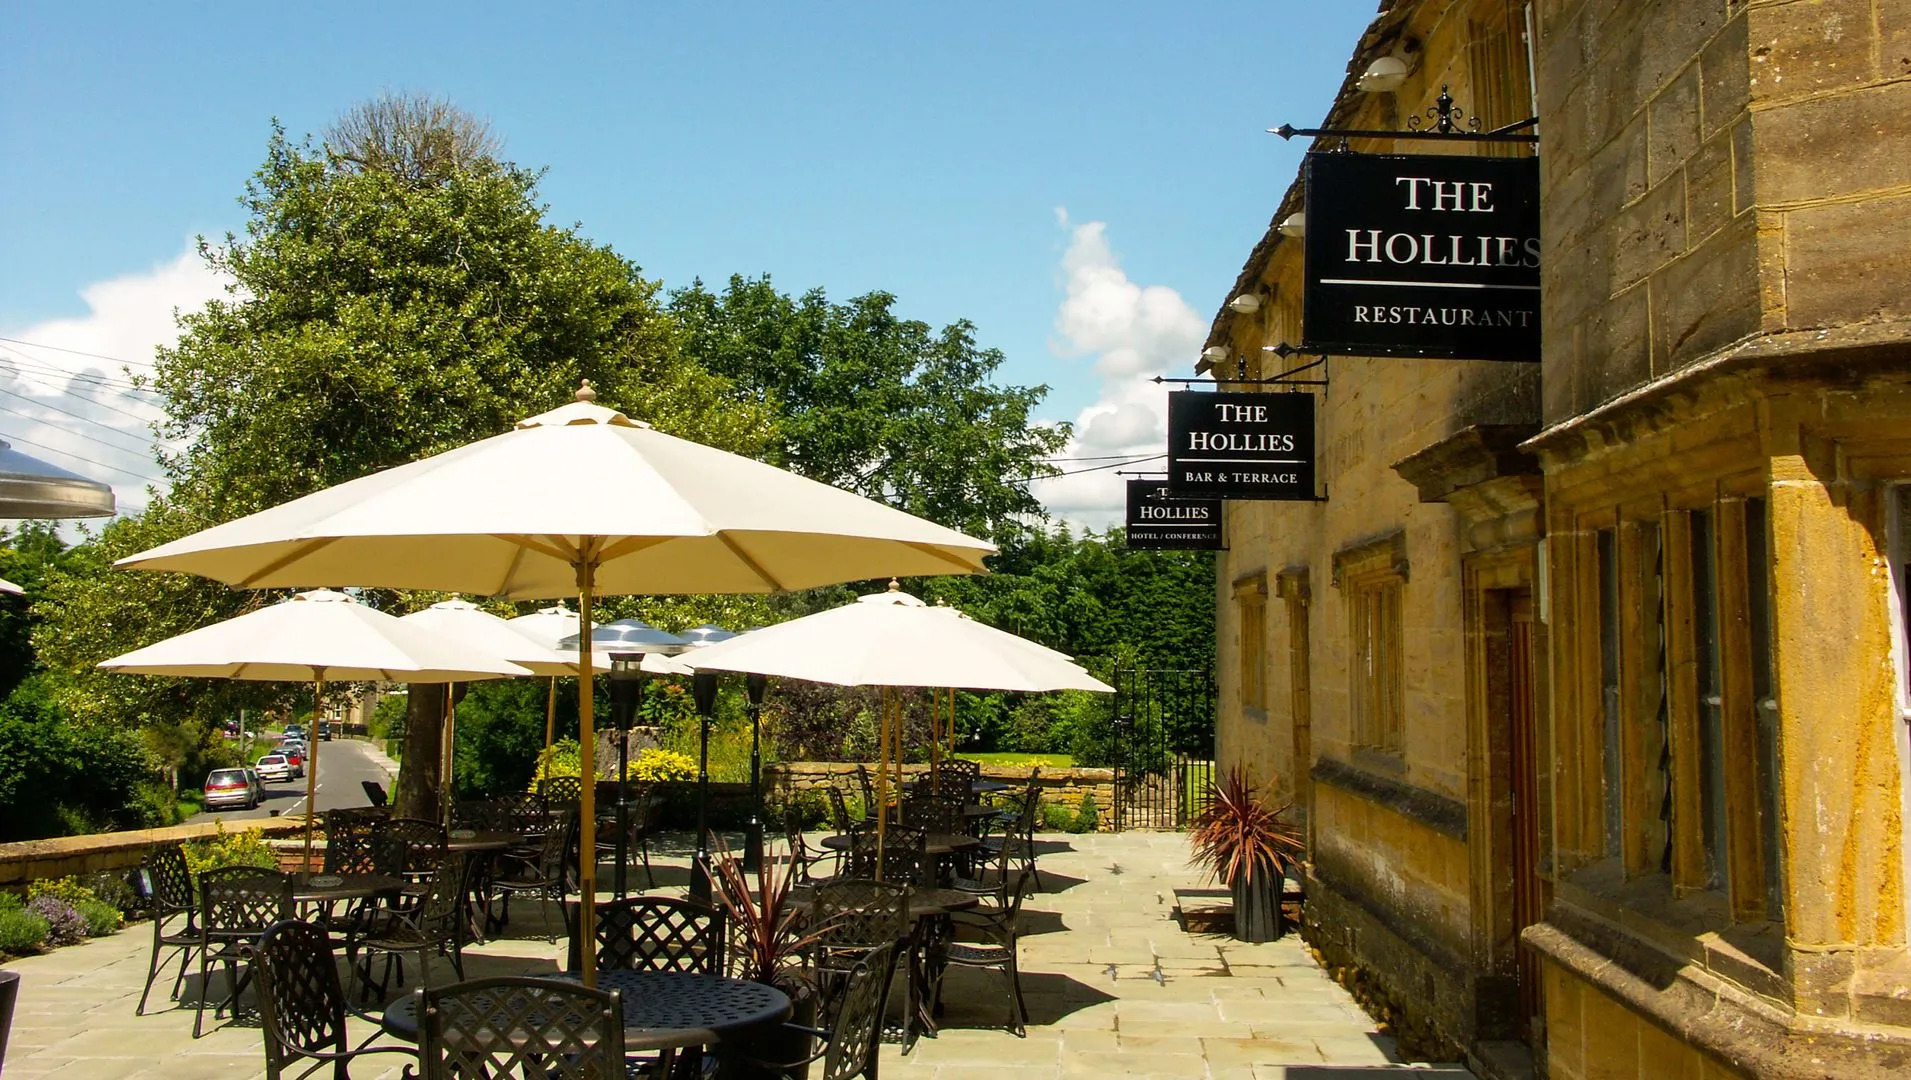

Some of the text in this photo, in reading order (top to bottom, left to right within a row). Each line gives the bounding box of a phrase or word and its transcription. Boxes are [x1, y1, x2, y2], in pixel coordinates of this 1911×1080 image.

[1396, 177, 1494, 212] THE
[1345, 229, 1541, 268] HOLLIES
[1354, 305, 1533, 328] RESTAURANT
[1215, 403, 1268, 423] THE
[1188, 431, 1294, 452] HOLLIES
[1185, 472, 1298, 484] BAR & TERRACE
[1140, 506, 1209, 519] HOLLIES
